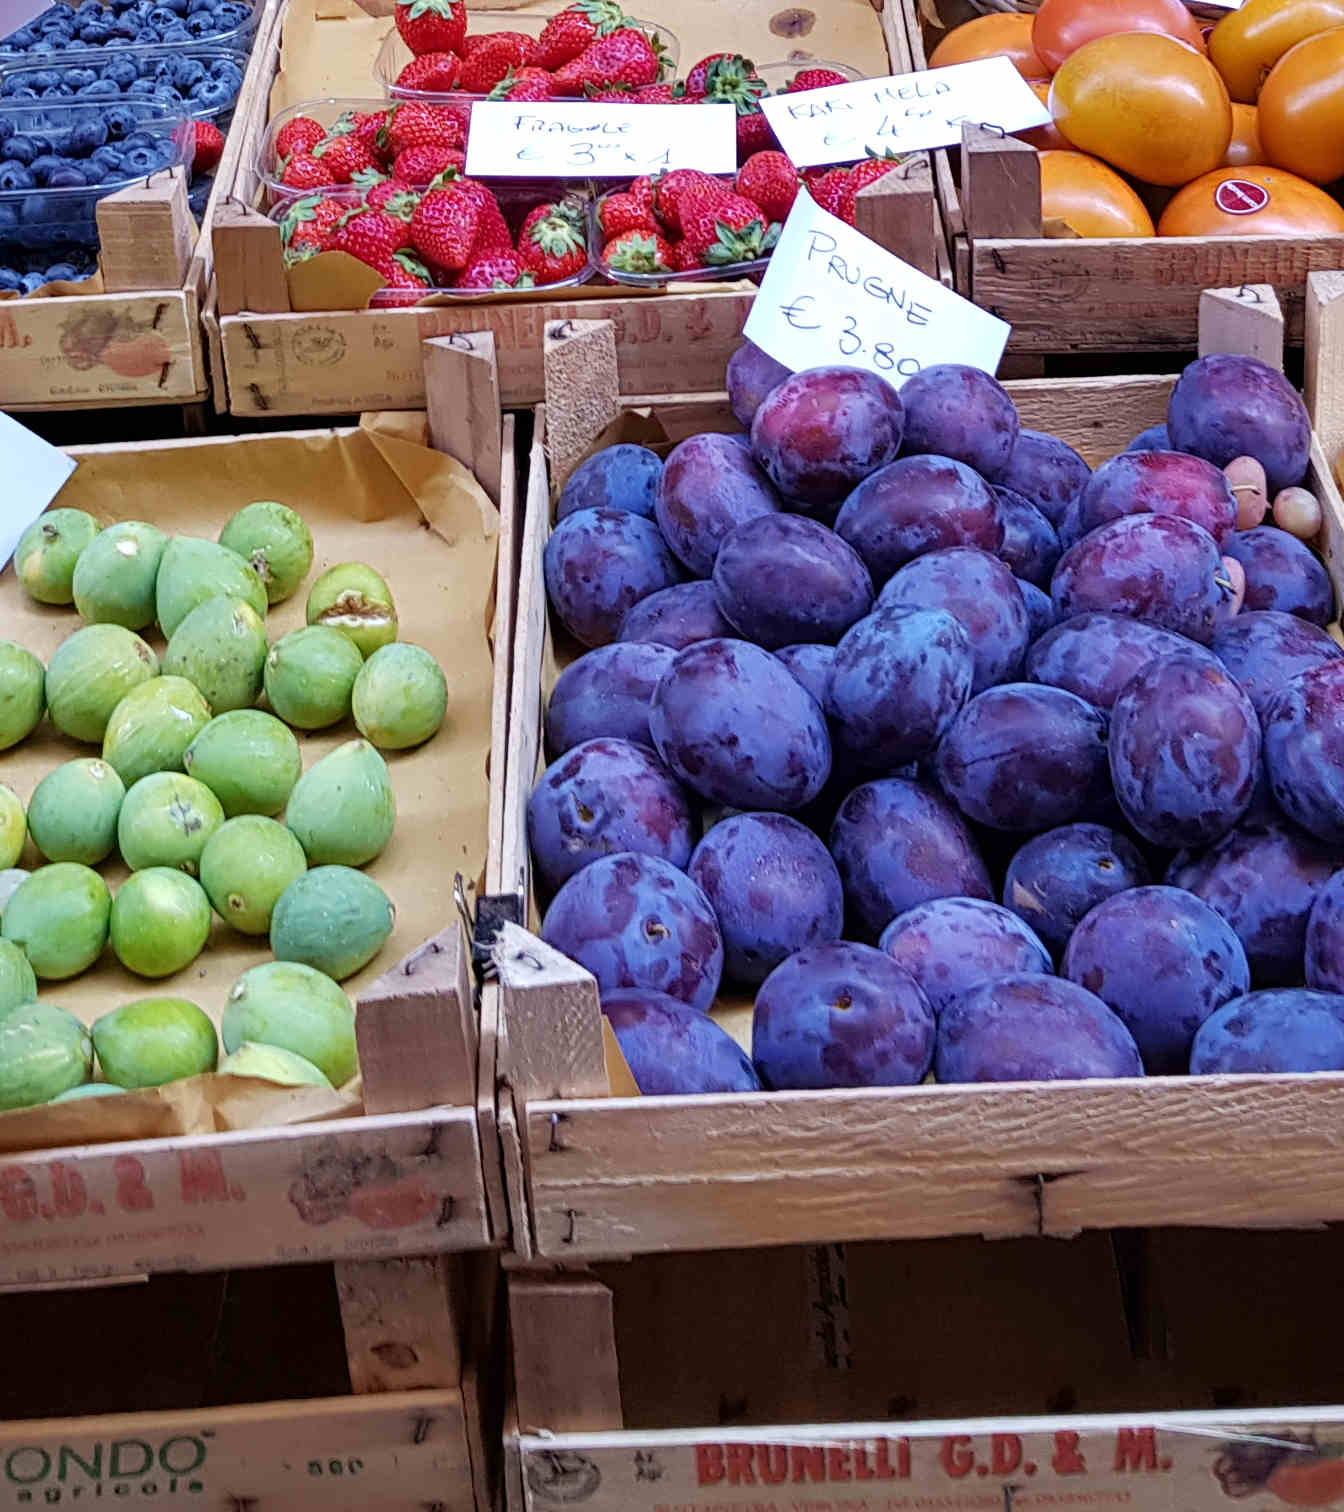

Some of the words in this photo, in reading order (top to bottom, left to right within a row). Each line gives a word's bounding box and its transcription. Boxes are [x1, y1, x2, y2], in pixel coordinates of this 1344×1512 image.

[806, 229, 933, 327] PRUGNE
[779, 295, 823, 330] €
[838, 315, 922, 377] 3.80
[694, 1434, 911, 1488] BRUNELLI
[939, 1433, 1037, 1479] G.D.
[1051, 1429, 1088, 1476] &
[1112, 1426, 1173, 1474] M.
